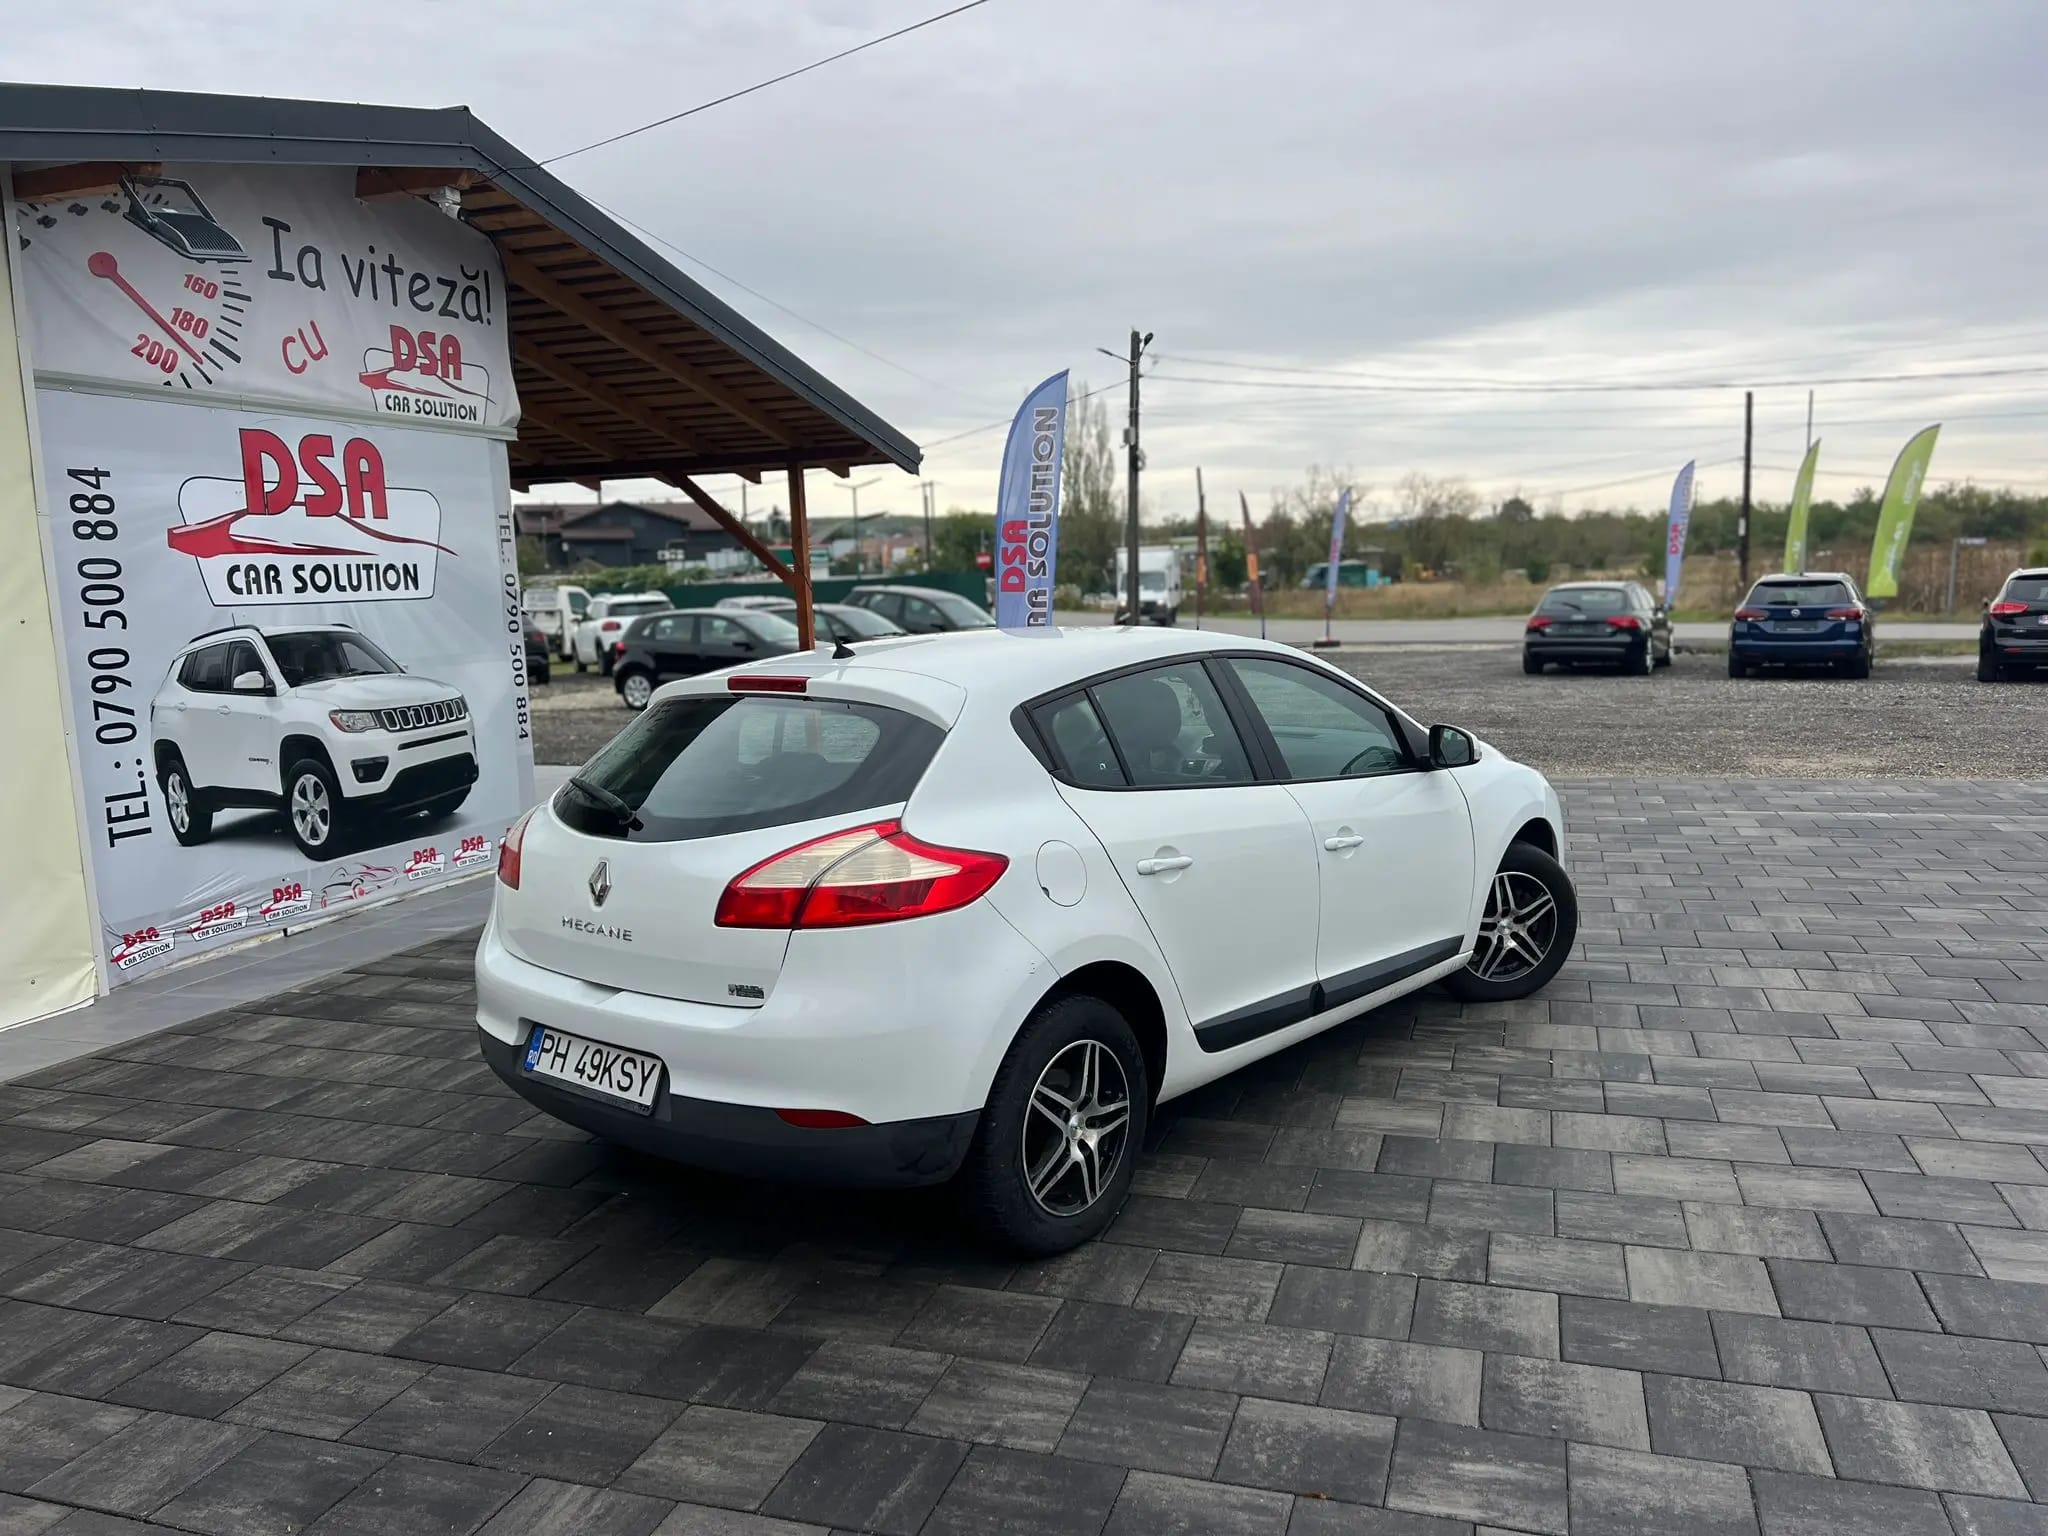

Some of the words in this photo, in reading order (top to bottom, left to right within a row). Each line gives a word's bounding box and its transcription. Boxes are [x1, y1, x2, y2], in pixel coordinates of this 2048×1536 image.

[184, 273, 219, 300] 160
[262, 216, 326, 291] Ia
[341, 245, 492, 326] viteză!
[170, 307, 209, 339] 180
[130, 334, 179, 374] 200
[389, 324, 462, 381] DSA
[385, 395, 411, 413] CAR
[414, 399, 477, 421] SOLUTION
[239, 428, 388, 519] DSA
[1027, 407, 1059, 579] SOLUTION
[67, 467, 119, 541] 884
[1001, 520, 1028, 592] DSA
[77, 558, 128, 630] 500
[226, 563, 283, 596] CAR
[292, 563, 419, 594] SOLUTION
[504, 573, 520, 634] 0790
[1026, 587, 1048, 627] AR
[510, 643, 525, 687] 500
[88, 648, 137, 745] 0790
[516, 697, 529, 740] 884
[105, 758, 152, 848] TEL.:
[200, 901, 236, 923] DSA
[268, 910, 281, 919] CAR
[281, 904, 308, 916] SOLUTION
[272, 882, 302, 904] DSA
[123, 926, 160, 948] DSA
[197, 928, 210, 938] CAR
[211, 921, 243, 935] SOLUTION
[562, 916, 632, 941] MEGANE
[124, 956, 138, 966] CAR
[138, 942, 171, 961] SOLUTION
[526, 1050, 538, 1064] RO
[536, 1033, 571, 1073] PH
[574, 1045, 656, 1097] 49KSY
